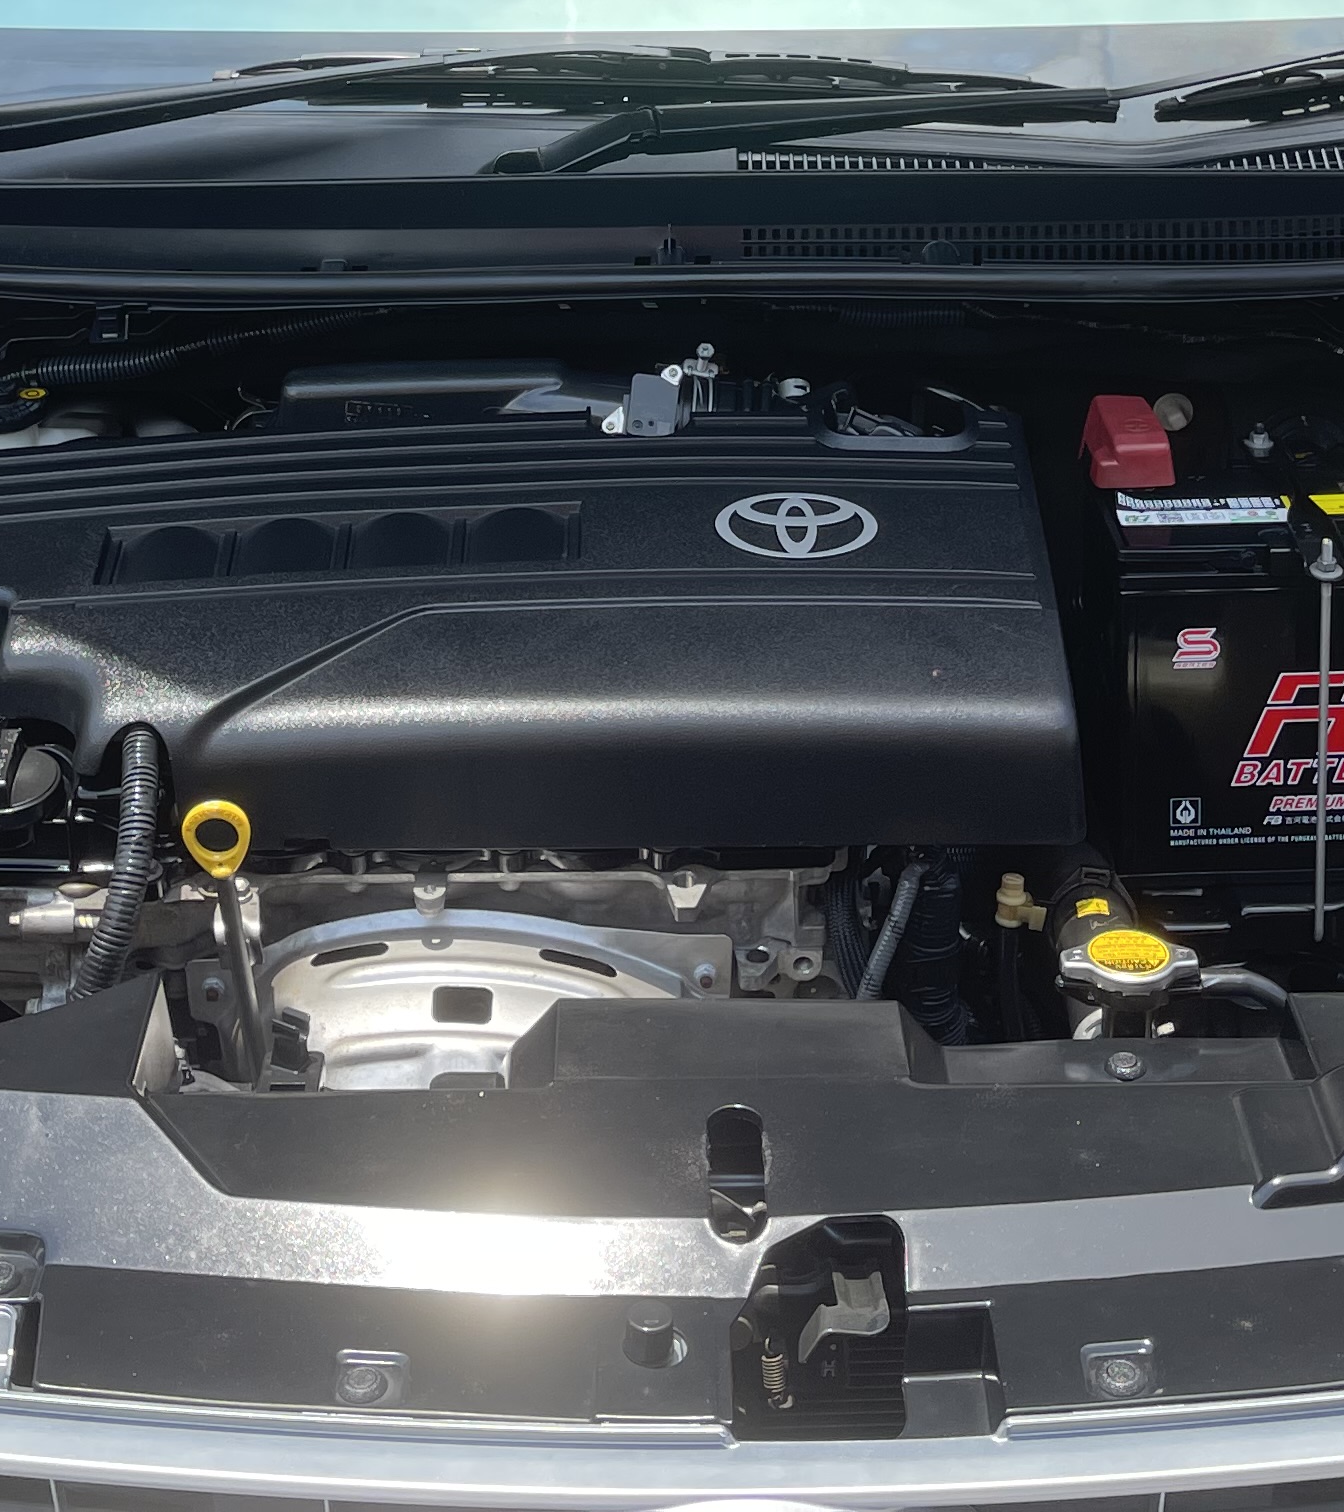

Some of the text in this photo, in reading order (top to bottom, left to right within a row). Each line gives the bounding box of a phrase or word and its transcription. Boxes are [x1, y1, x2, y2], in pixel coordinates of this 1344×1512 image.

[1262, 815, 1283, 825] FB
[1170, 827, 1252, 837] MADE IN THAILAND
